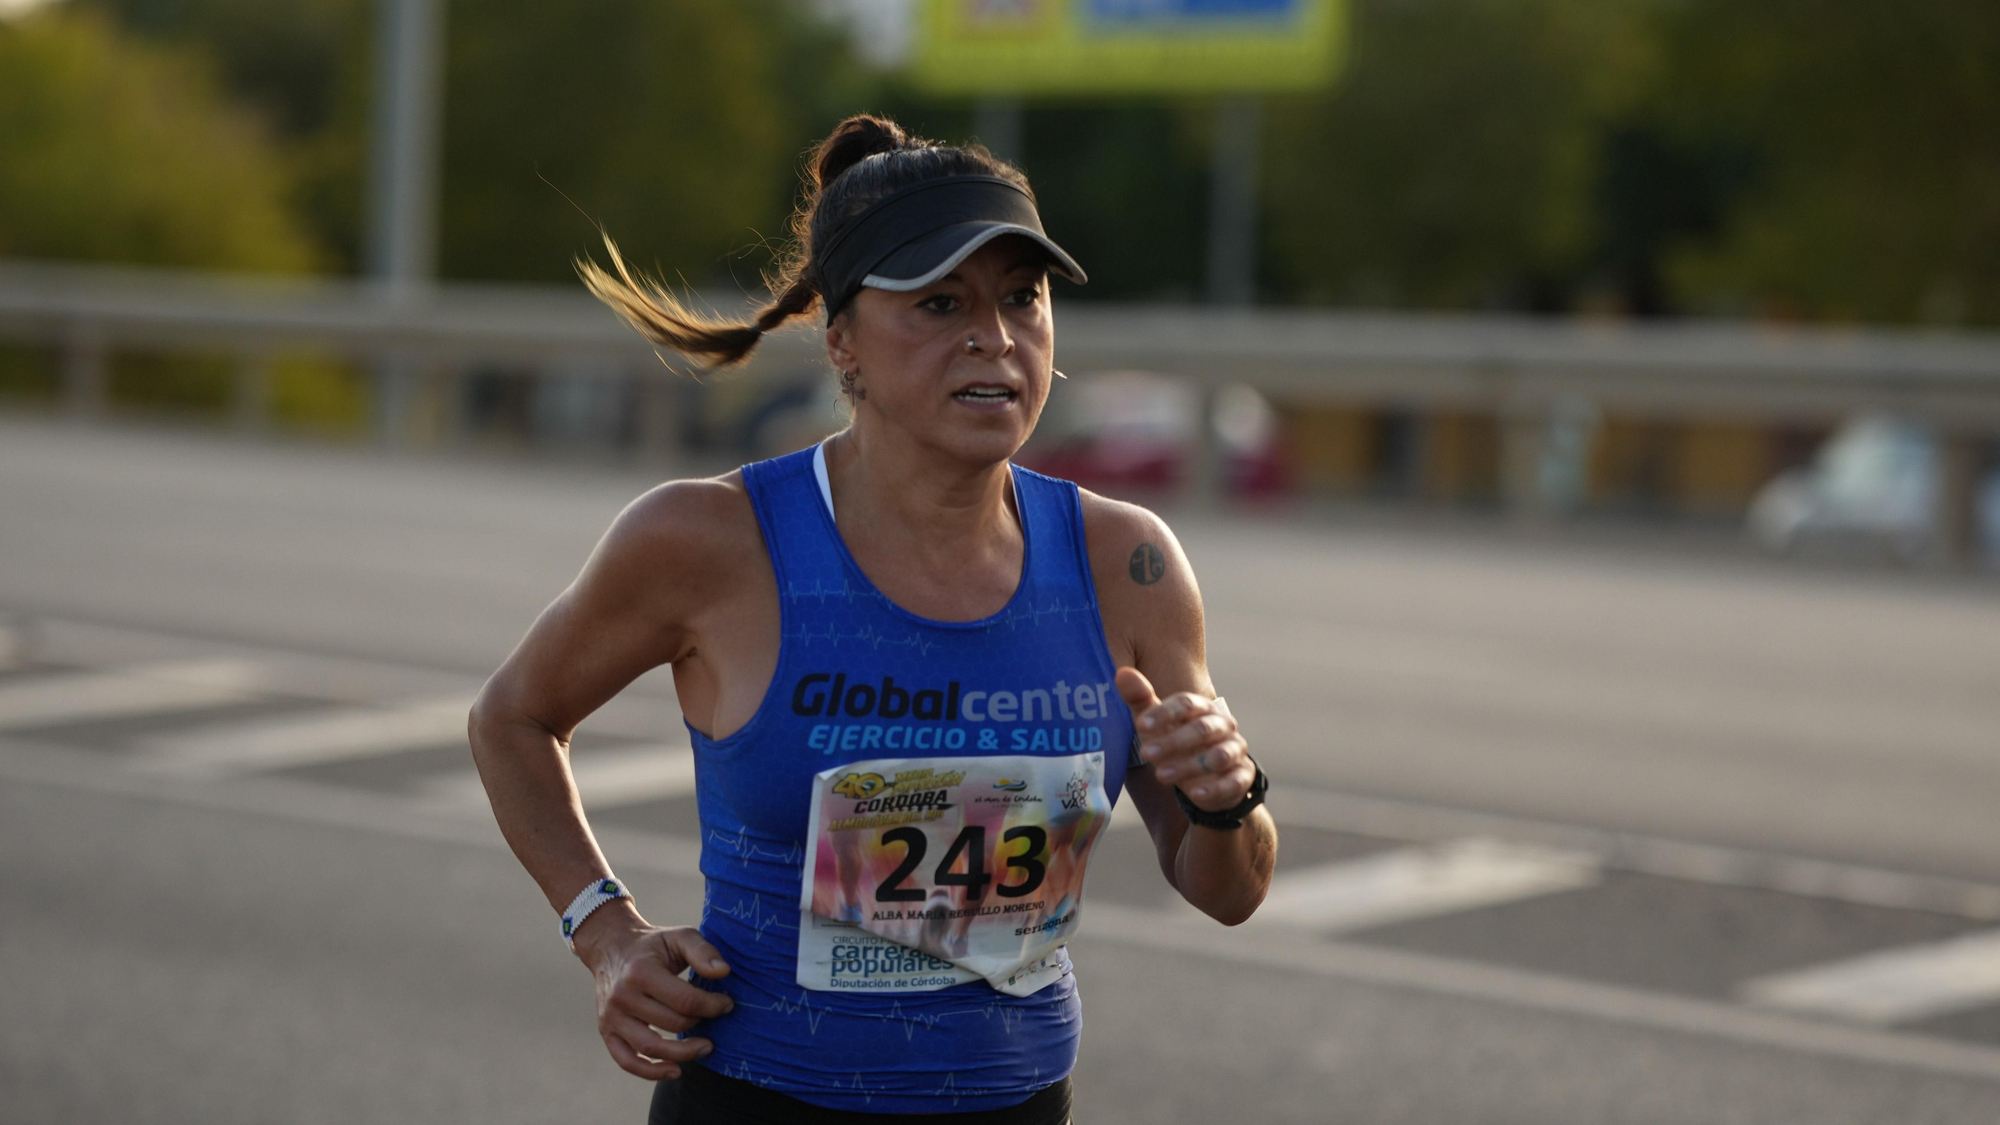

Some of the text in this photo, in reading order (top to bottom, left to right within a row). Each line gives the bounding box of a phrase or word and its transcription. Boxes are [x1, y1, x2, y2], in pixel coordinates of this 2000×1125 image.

[792, 673, 1110, 722] Globalcenter
[808, 725, 1102, 755] EJERCICIO & SALUD
[875, 824, 1048, 902] 243
[872, 911, 903, 921] ALBA
[1003, 901, 1045, 913] MORENO
[832, 935, 879, 945] CIRCUITO
[830, 975, 957, 989] Diputación de Córdoba
